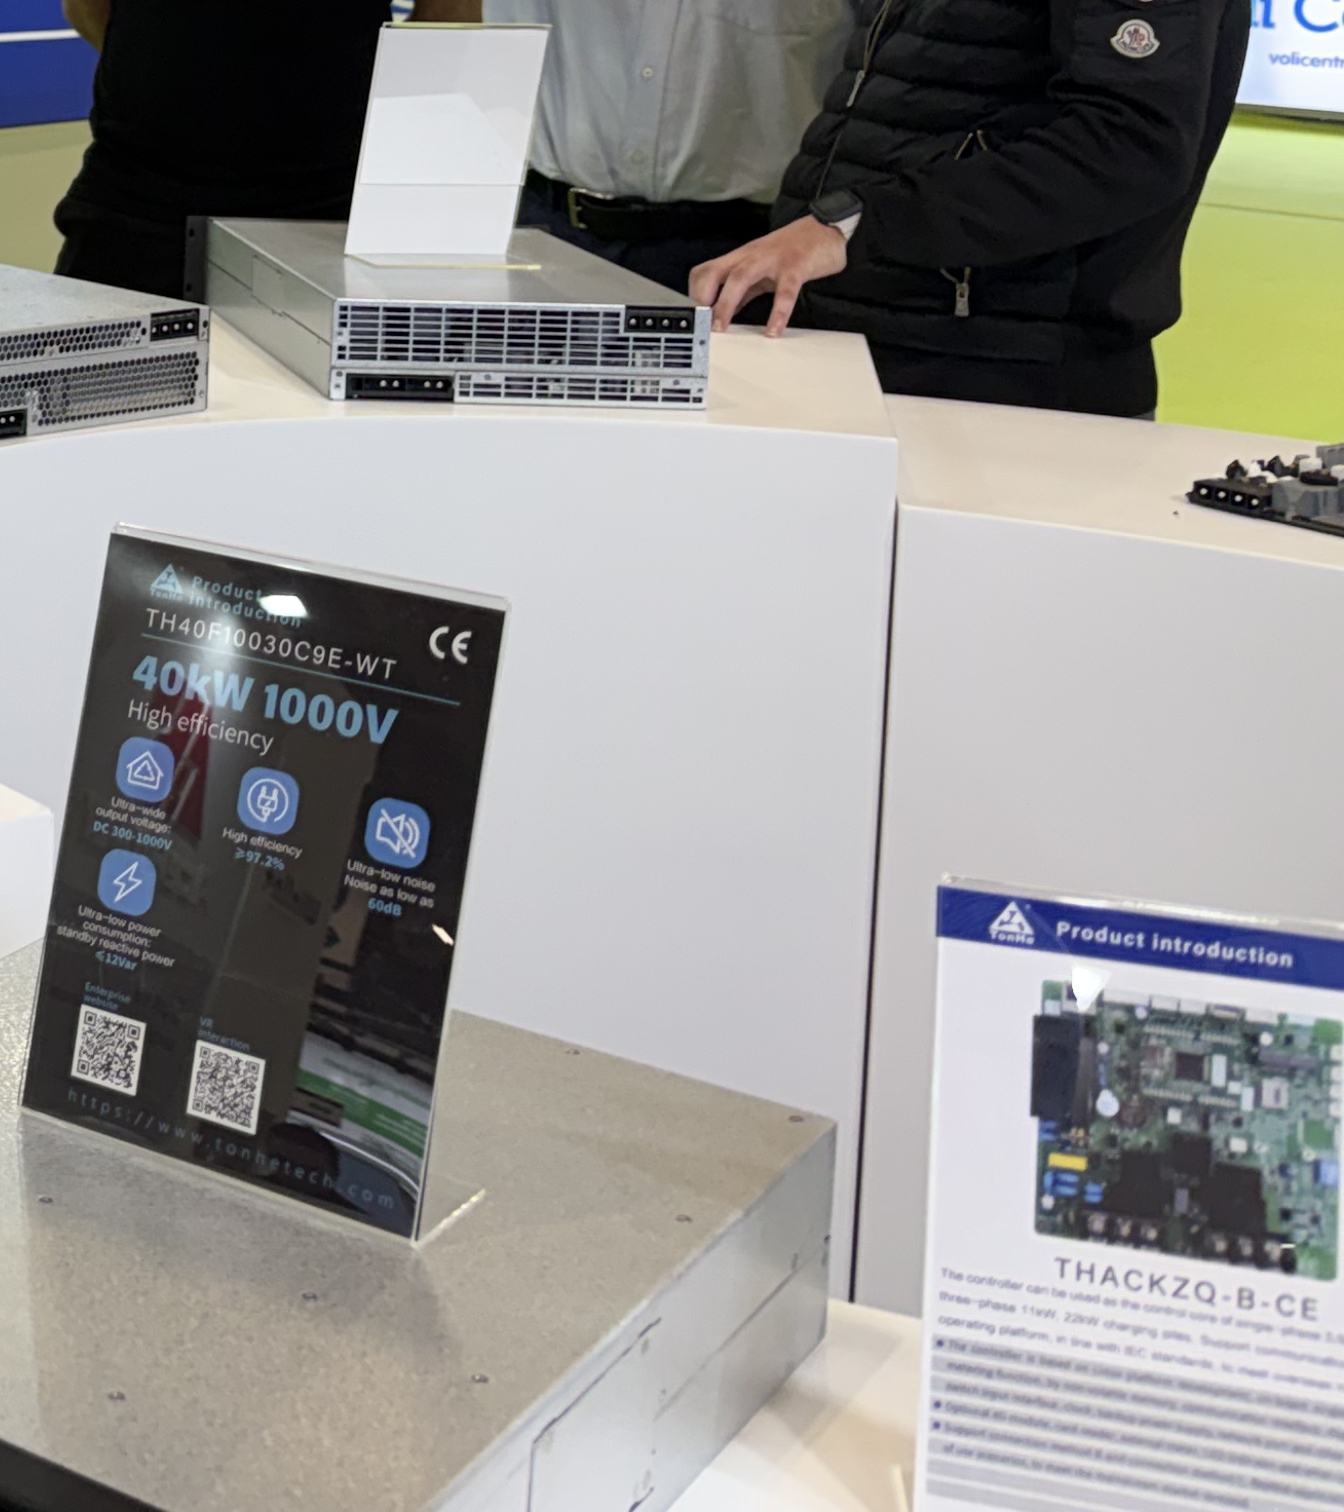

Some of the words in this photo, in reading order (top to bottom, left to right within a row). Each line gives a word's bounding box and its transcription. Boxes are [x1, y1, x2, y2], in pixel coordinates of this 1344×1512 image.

[192, 574, 263, 601] Product
[429, 626, 473, 664] CE
[132, 654, 256, 714] 40kW
[263, 683, 400, 745] 1000V
[128, 699, 173, 734] High
[176, 710, 275, 756] efficiency
[95, 806, 129, 823] output
[130, 815, 173, 834] voltage:
[111, 795, 167, 820] Ultra-wide
[92, 820, 110, 834] DC
[111, 825, 173, 851] 300-1000V
[222, 827, 248, 844] High
[250, 836, 303, 860] efficiency
[344, 874, 378, 894] Noise
[379, 886, 394, 898] as
[397, 888, 418, 904] low
[419, 896, 434, 908] as
[347, 859, 402, 883] Ultra-low
[403, 876, 436, 893] noise
[78, 904, 127, 928] Ultra-low
[127, 921, 162, 938] power
[368, 898, 402, 916] 60dB
[57, 925, 98, 947] standby
[99, 938, 141, 958] reactive
[141, 950, 175, 967] power
[82, 920, 152, 948] consumption:
[1056, 921, 1145, 949] Product
[1152, 932, 1293, 968] introduction
